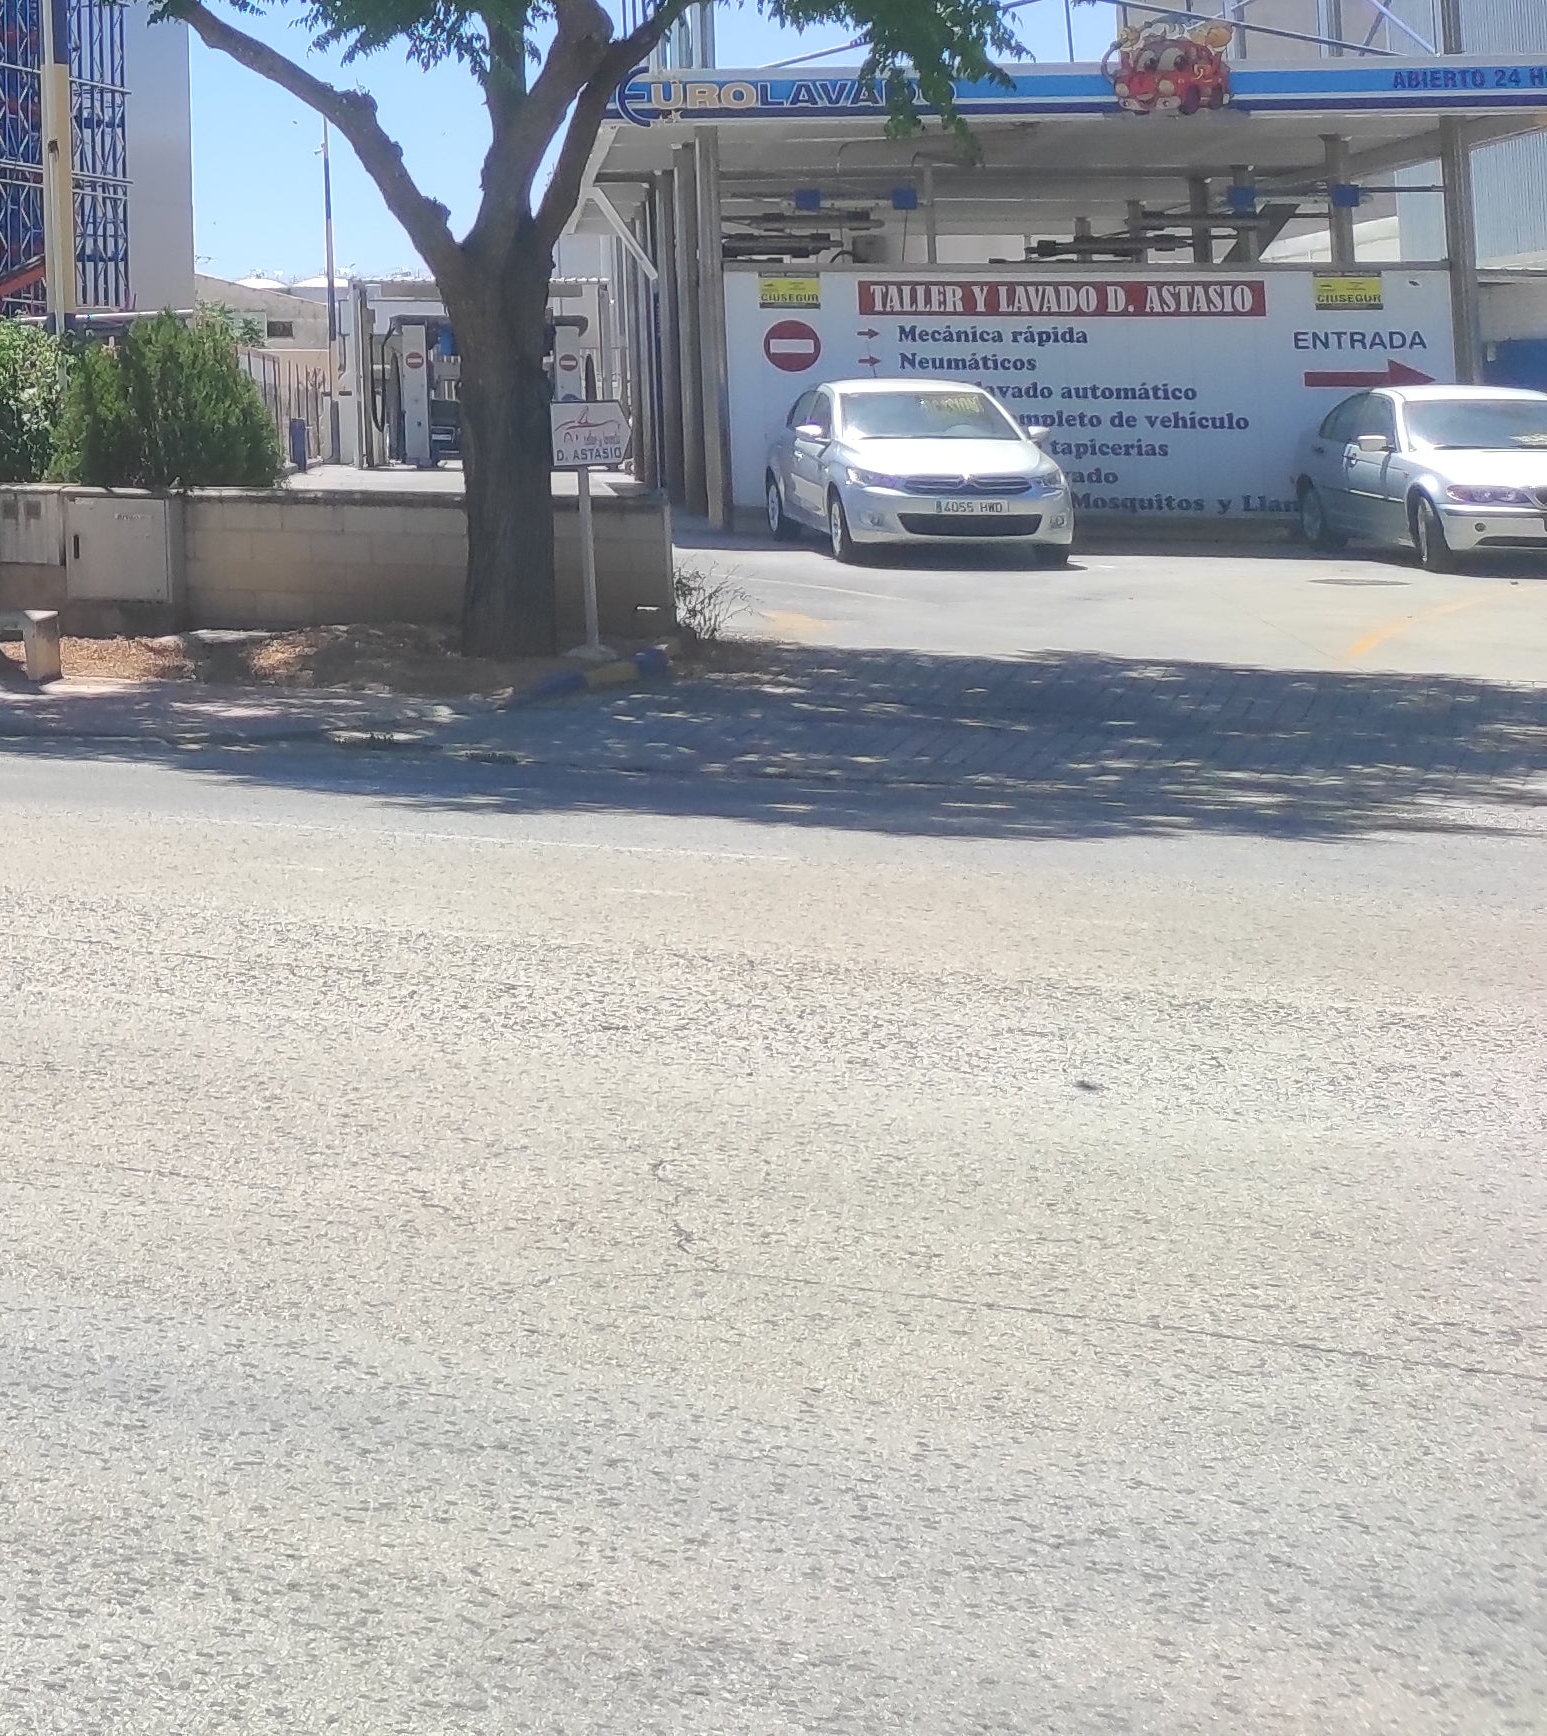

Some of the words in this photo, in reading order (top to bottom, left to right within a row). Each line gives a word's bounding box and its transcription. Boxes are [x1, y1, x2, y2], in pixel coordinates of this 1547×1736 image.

[1393, 68, 1486, 89] ABIERTO
[1494, 68, 1521, 87] 24
[1529, 67, 1547, 87] H
[870, 285, 963, 313] TALLER
[971, 285, 988, 313] Y
[997, 285, 1097, 313] LAVADO
[1106, 285, 1135, 313] D.
[1144, 284, 1253, 313] ASTASIO
[897, 325, 1003, 343] Mecánica
[1011, 325, 1088, 347] rápida
[1293, 330, 1427, 350] ENTRADA
[898, 353, 1037, 371] Neumáticos
[977, 381, 1054, 399] avado
[1060, 382, 1197, 401] automático
[1110, 410, 1137, 428] de
[1144, 411, 1250, 430] vehículo
[573, 447, 622, 462] ASTASIO
[1071, 492, 1205, 513] Mosquitos
[1217, 498, 1232, 514] y
[1241, 494, 1300, 512] Llan
